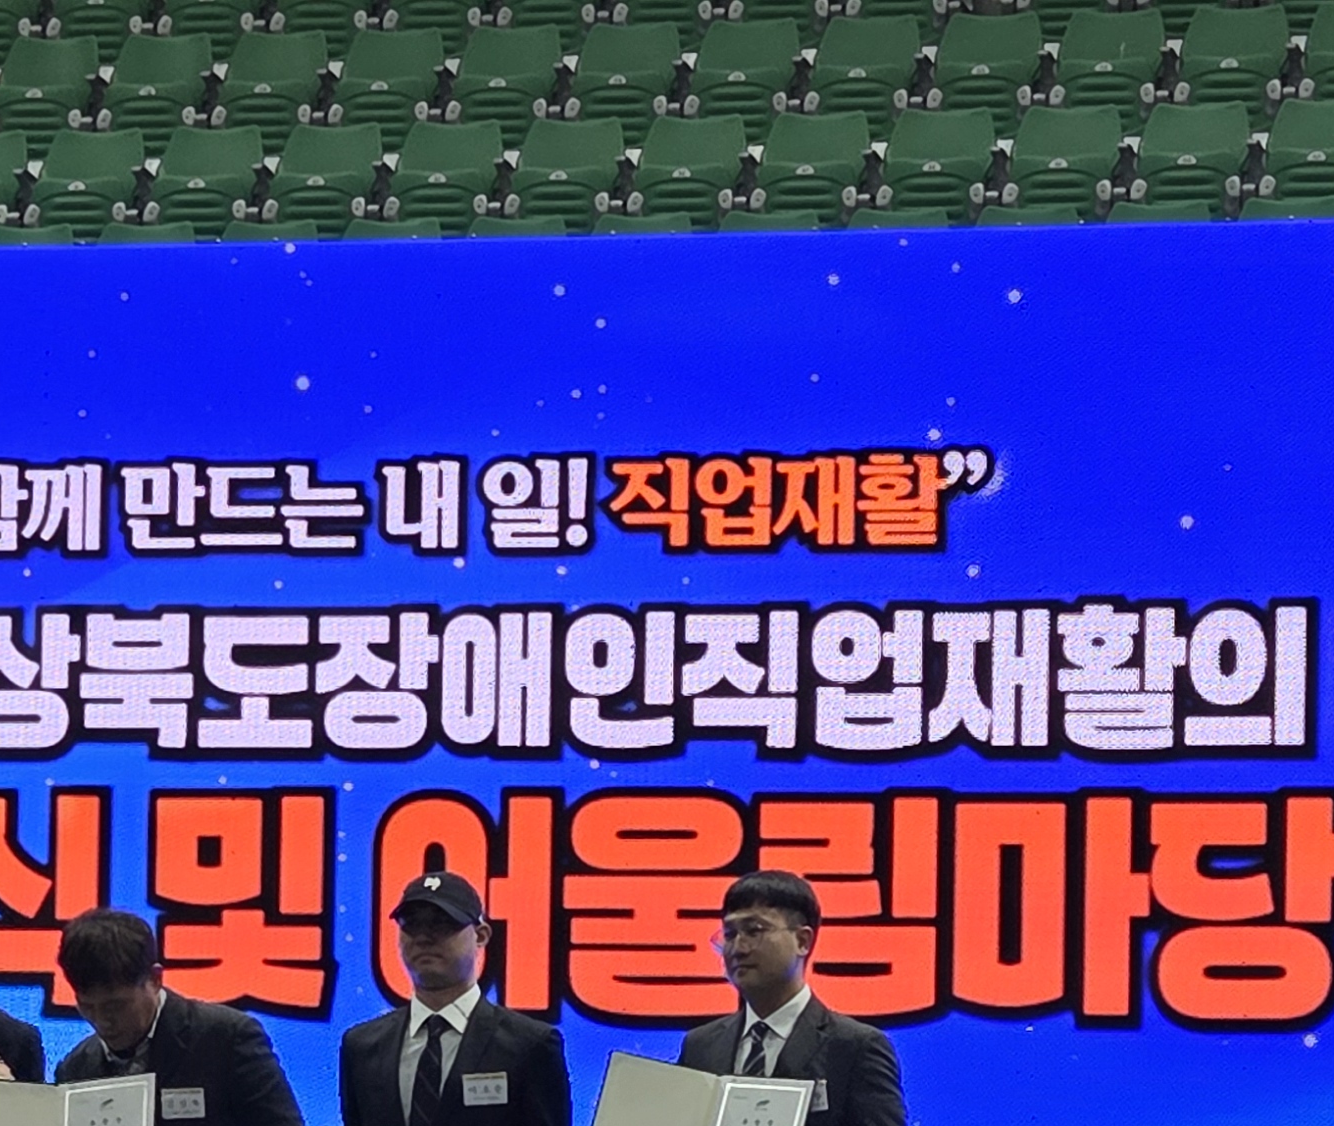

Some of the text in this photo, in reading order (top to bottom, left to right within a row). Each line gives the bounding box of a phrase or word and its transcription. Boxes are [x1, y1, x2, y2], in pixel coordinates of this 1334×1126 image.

[120, 463, 365, 550] 만드는
[381, 459, 462, 550] 내
[484, 457, 590, 548] 일!
[154, 796, 325, 1010] 및
